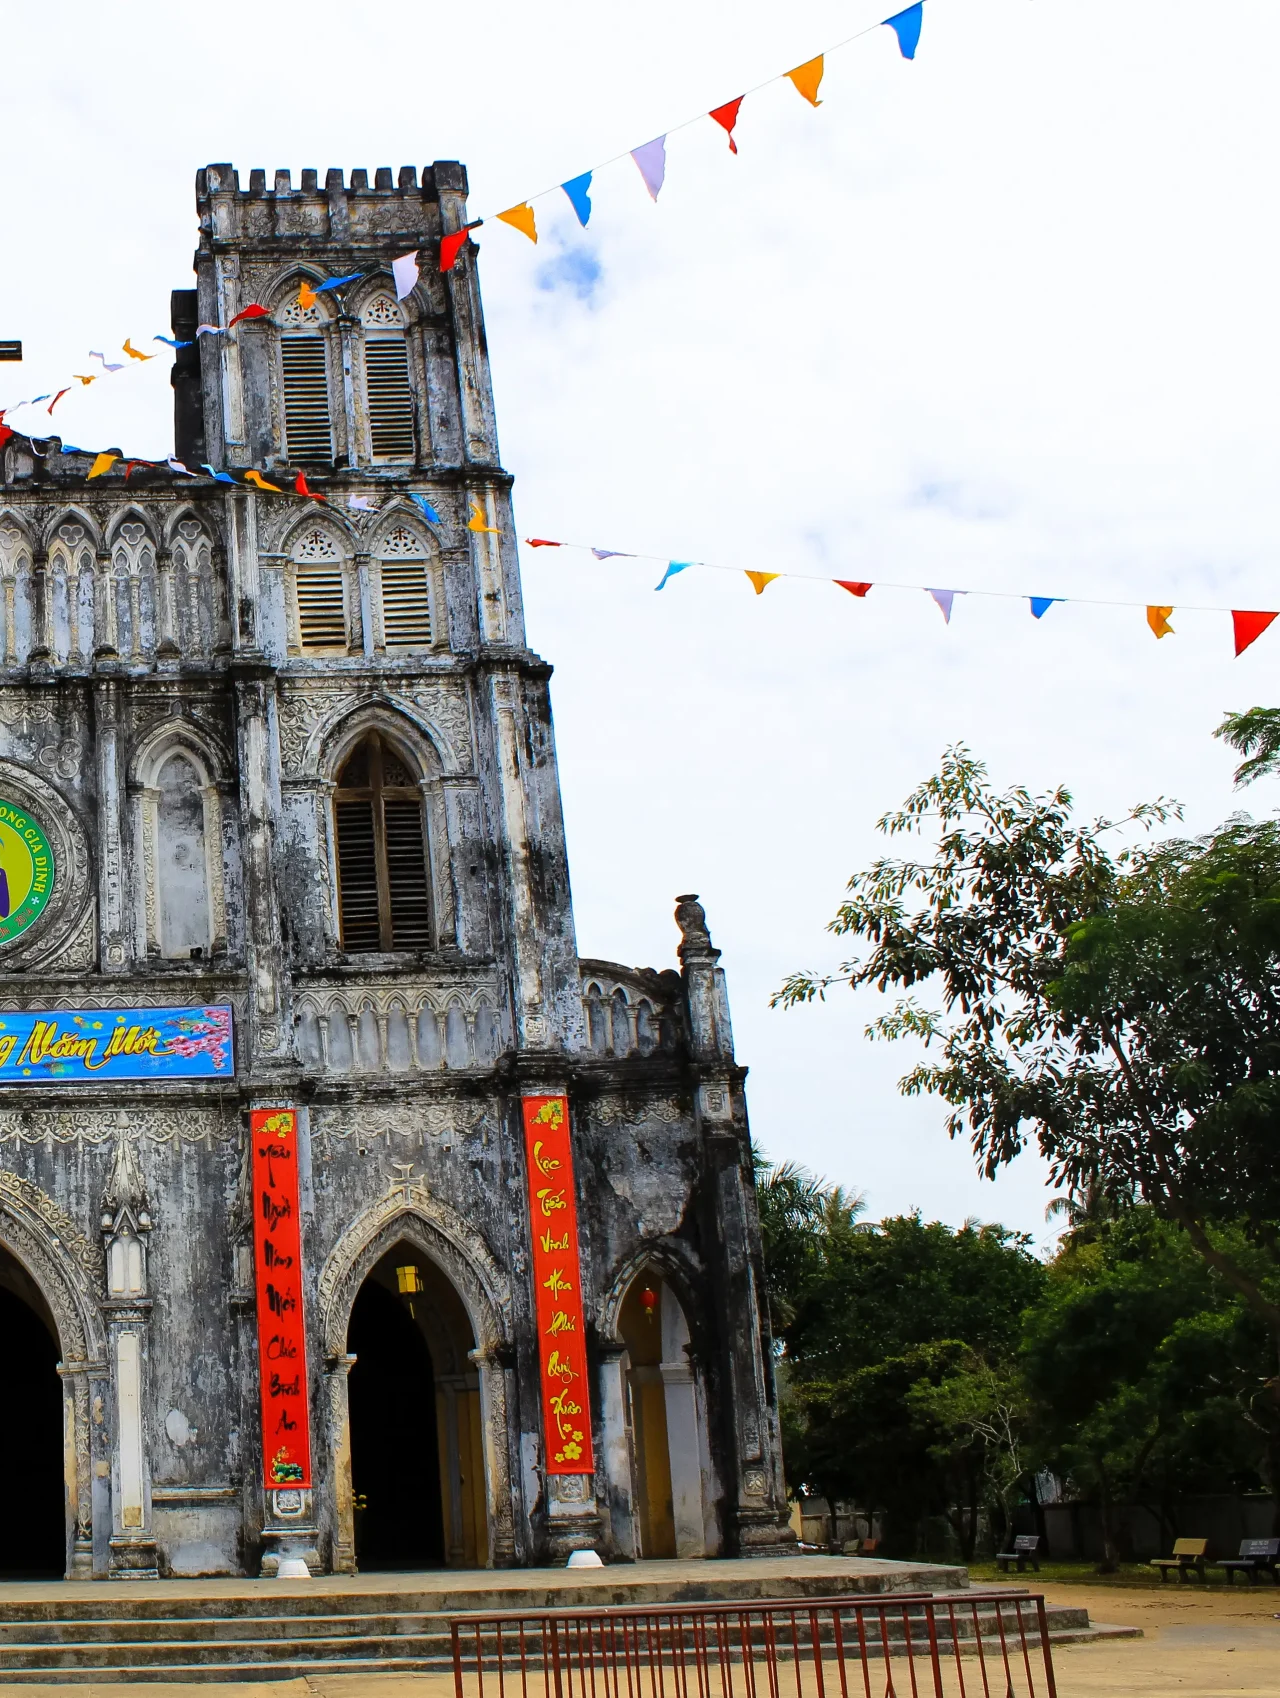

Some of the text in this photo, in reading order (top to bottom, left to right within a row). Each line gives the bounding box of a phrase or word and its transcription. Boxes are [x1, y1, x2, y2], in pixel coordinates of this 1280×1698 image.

[24, 828, 43, 854] GIA
[15, 1020, 109, 1070] Năm
[104, 1025, 176, 1057] Mới
[258, 1143, 291, 1188] Yêu
[533, 1141, 563, 1179] Lộc
[536, 1188, 567, 1217] Tiến
[540, 1227, 569, 1253] Vinh
[266, 1278, 297, 1322] Mới
[545, 1310, 576, 1337] Phú
[267, 1335, 297, 1361] Chúc
[548, 1350, 579, 1384] Quý
[268, 1371, 300, 1398] Bình
[275, 1409, 298, 1434] An
[550, 1387, 582, 1440] Xuân
